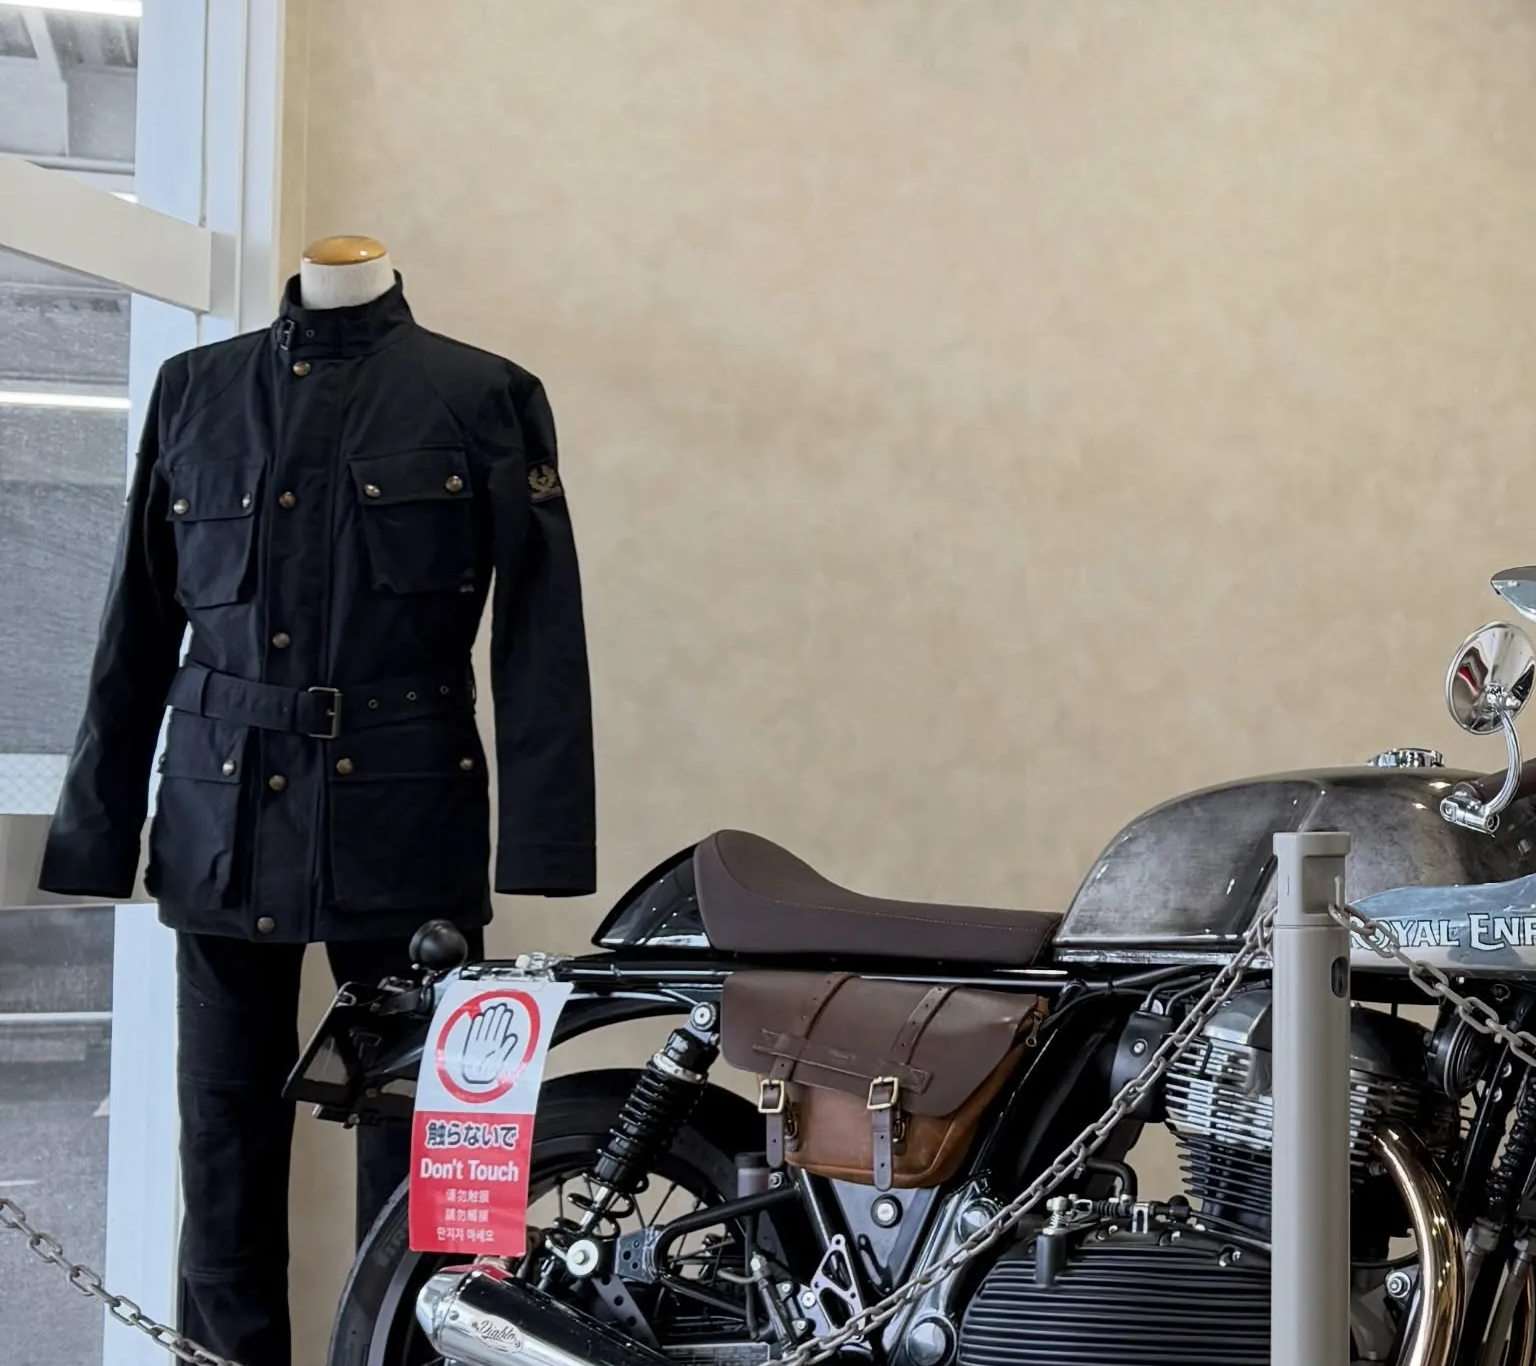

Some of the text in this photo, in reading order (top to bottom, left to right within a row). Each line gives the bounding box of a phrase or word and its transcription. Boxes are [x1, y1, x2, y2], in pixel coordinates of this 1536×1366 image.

[426, 1120, 519, 1149] 触らないで
[420, 1158, 519, 1182] Don't Touch
